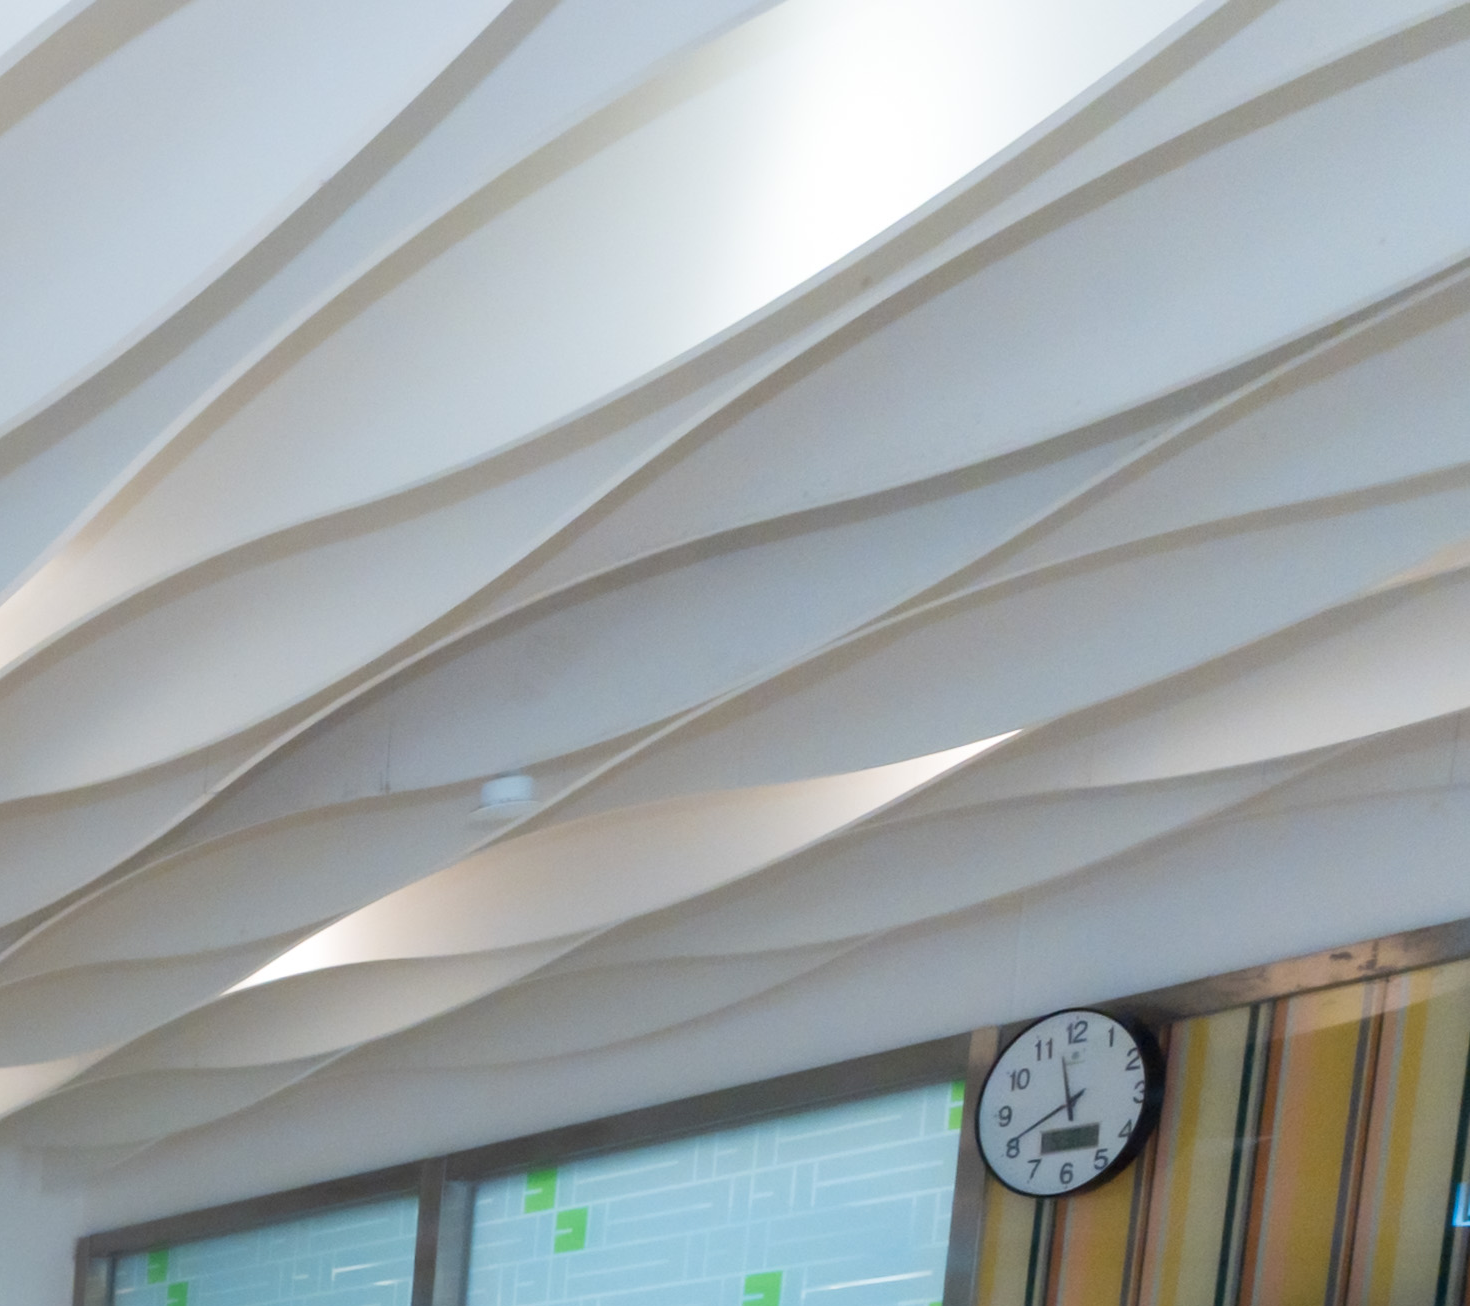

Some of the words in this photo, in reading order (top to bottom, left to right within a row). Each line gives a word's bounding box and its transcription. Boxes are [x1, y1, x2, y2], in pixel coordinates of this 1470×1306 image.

[1066, 1020, 1089, 1045] 12
[1108, 1026, 1115, 1047] 1
[1035, 1038, 1053, 1061] 11
[1125, 1047, 1141, 1071] 2
[1009, 1068, 1031, 1092] 10
[1133, 1080, 1146, 1104] 3
[998, 1105, 1013, 1127] 9
[1118, 1119, 1134, 1139] 4
[1006, 1137, 1021, 1159] 8
[1027, 1158, 1042, 1180] 7
[1094, 1149, 1109, 1171] 5
[1059, 1162, 1074, 1185] 6
